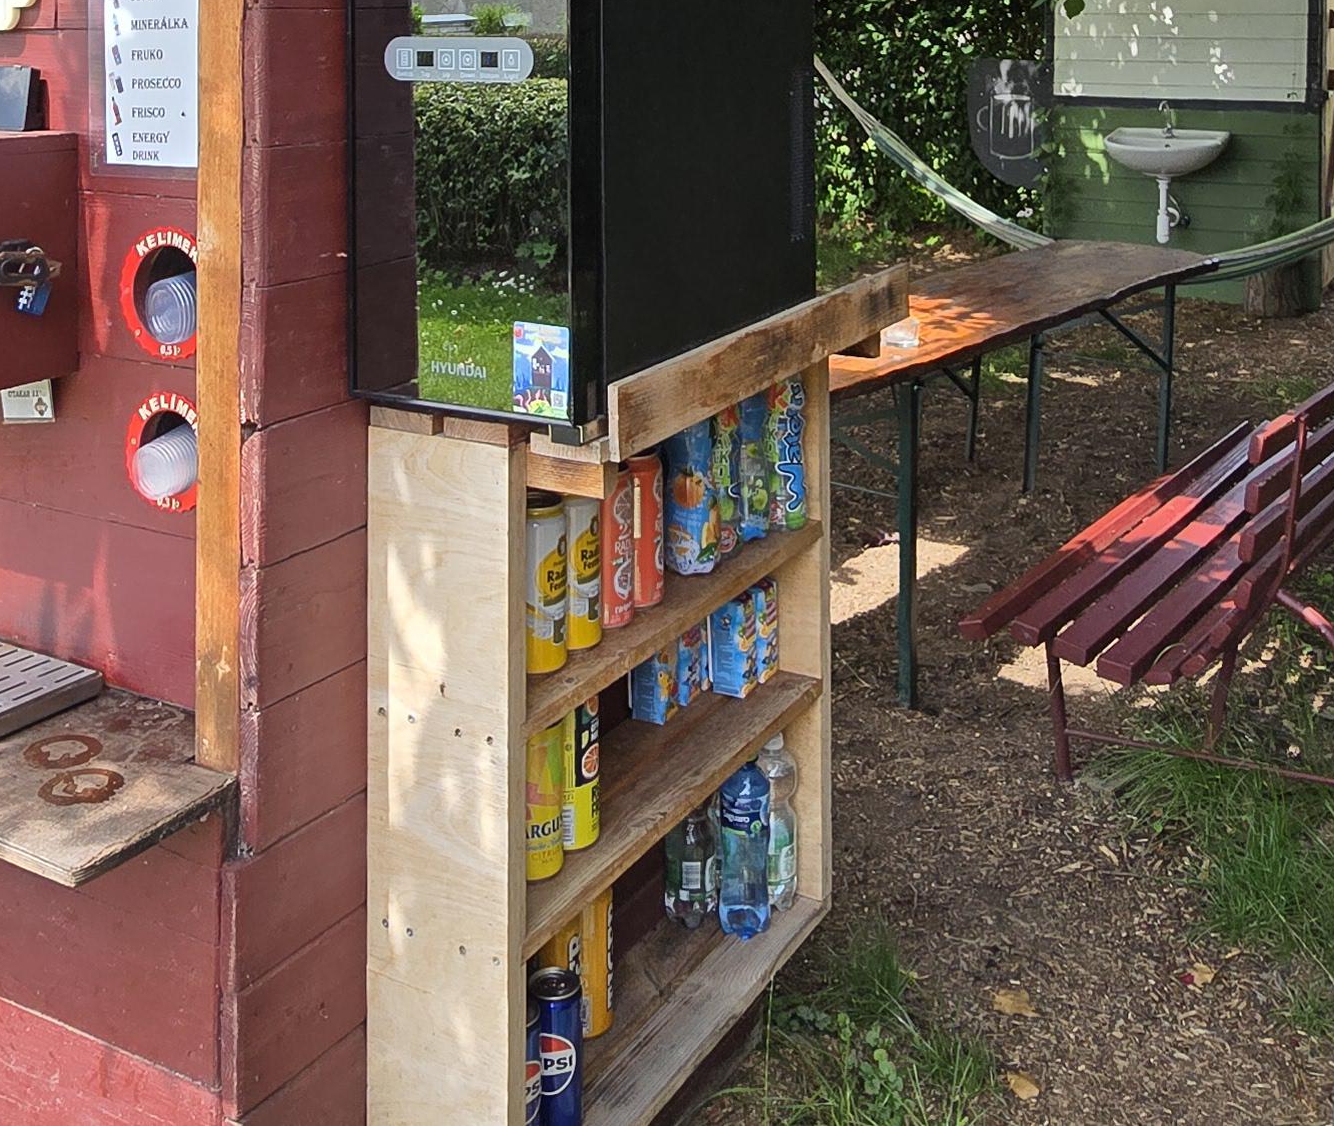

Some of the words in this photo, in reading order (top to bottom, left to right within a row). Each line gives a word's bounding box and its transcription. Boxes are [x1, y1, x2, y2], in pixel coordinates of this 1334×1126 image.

[130, 16, 189, 30] MINERÁLKA
[131, 49, 163, 61] FRUKO
[132, 77, 182, 89] PROSECCO
[132, 107, 166, 118] FRISCO
[132, 130, 170, 143] ENERGY
[132, 150, 160, 161] DRINK
[431, 360, 487, 379] HYUNDAI
